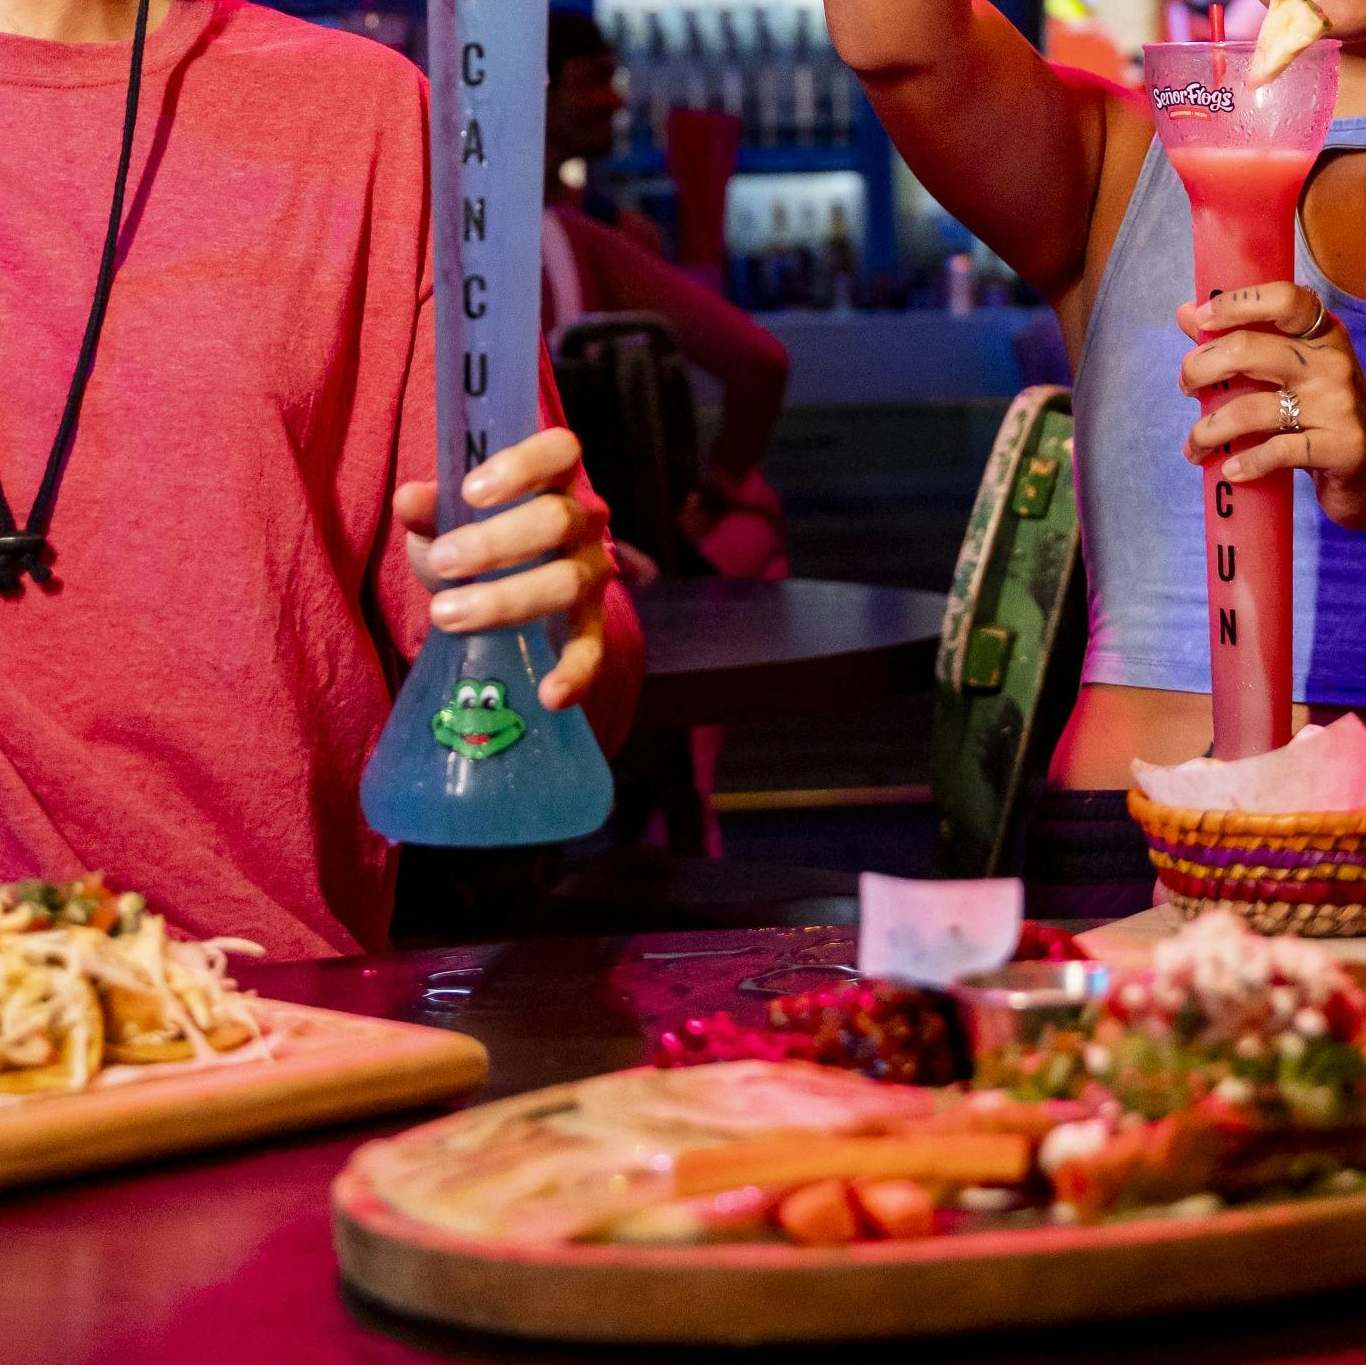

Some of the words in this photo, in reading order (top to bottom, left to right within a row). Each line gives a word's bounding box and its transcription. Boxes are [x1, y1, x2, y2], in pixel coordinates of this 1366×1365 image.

[1152, 86, 1187, 110] Señor
[1185, 81, 1235, 113] Frog's
[461, 41, 489, 474] CANCUN
